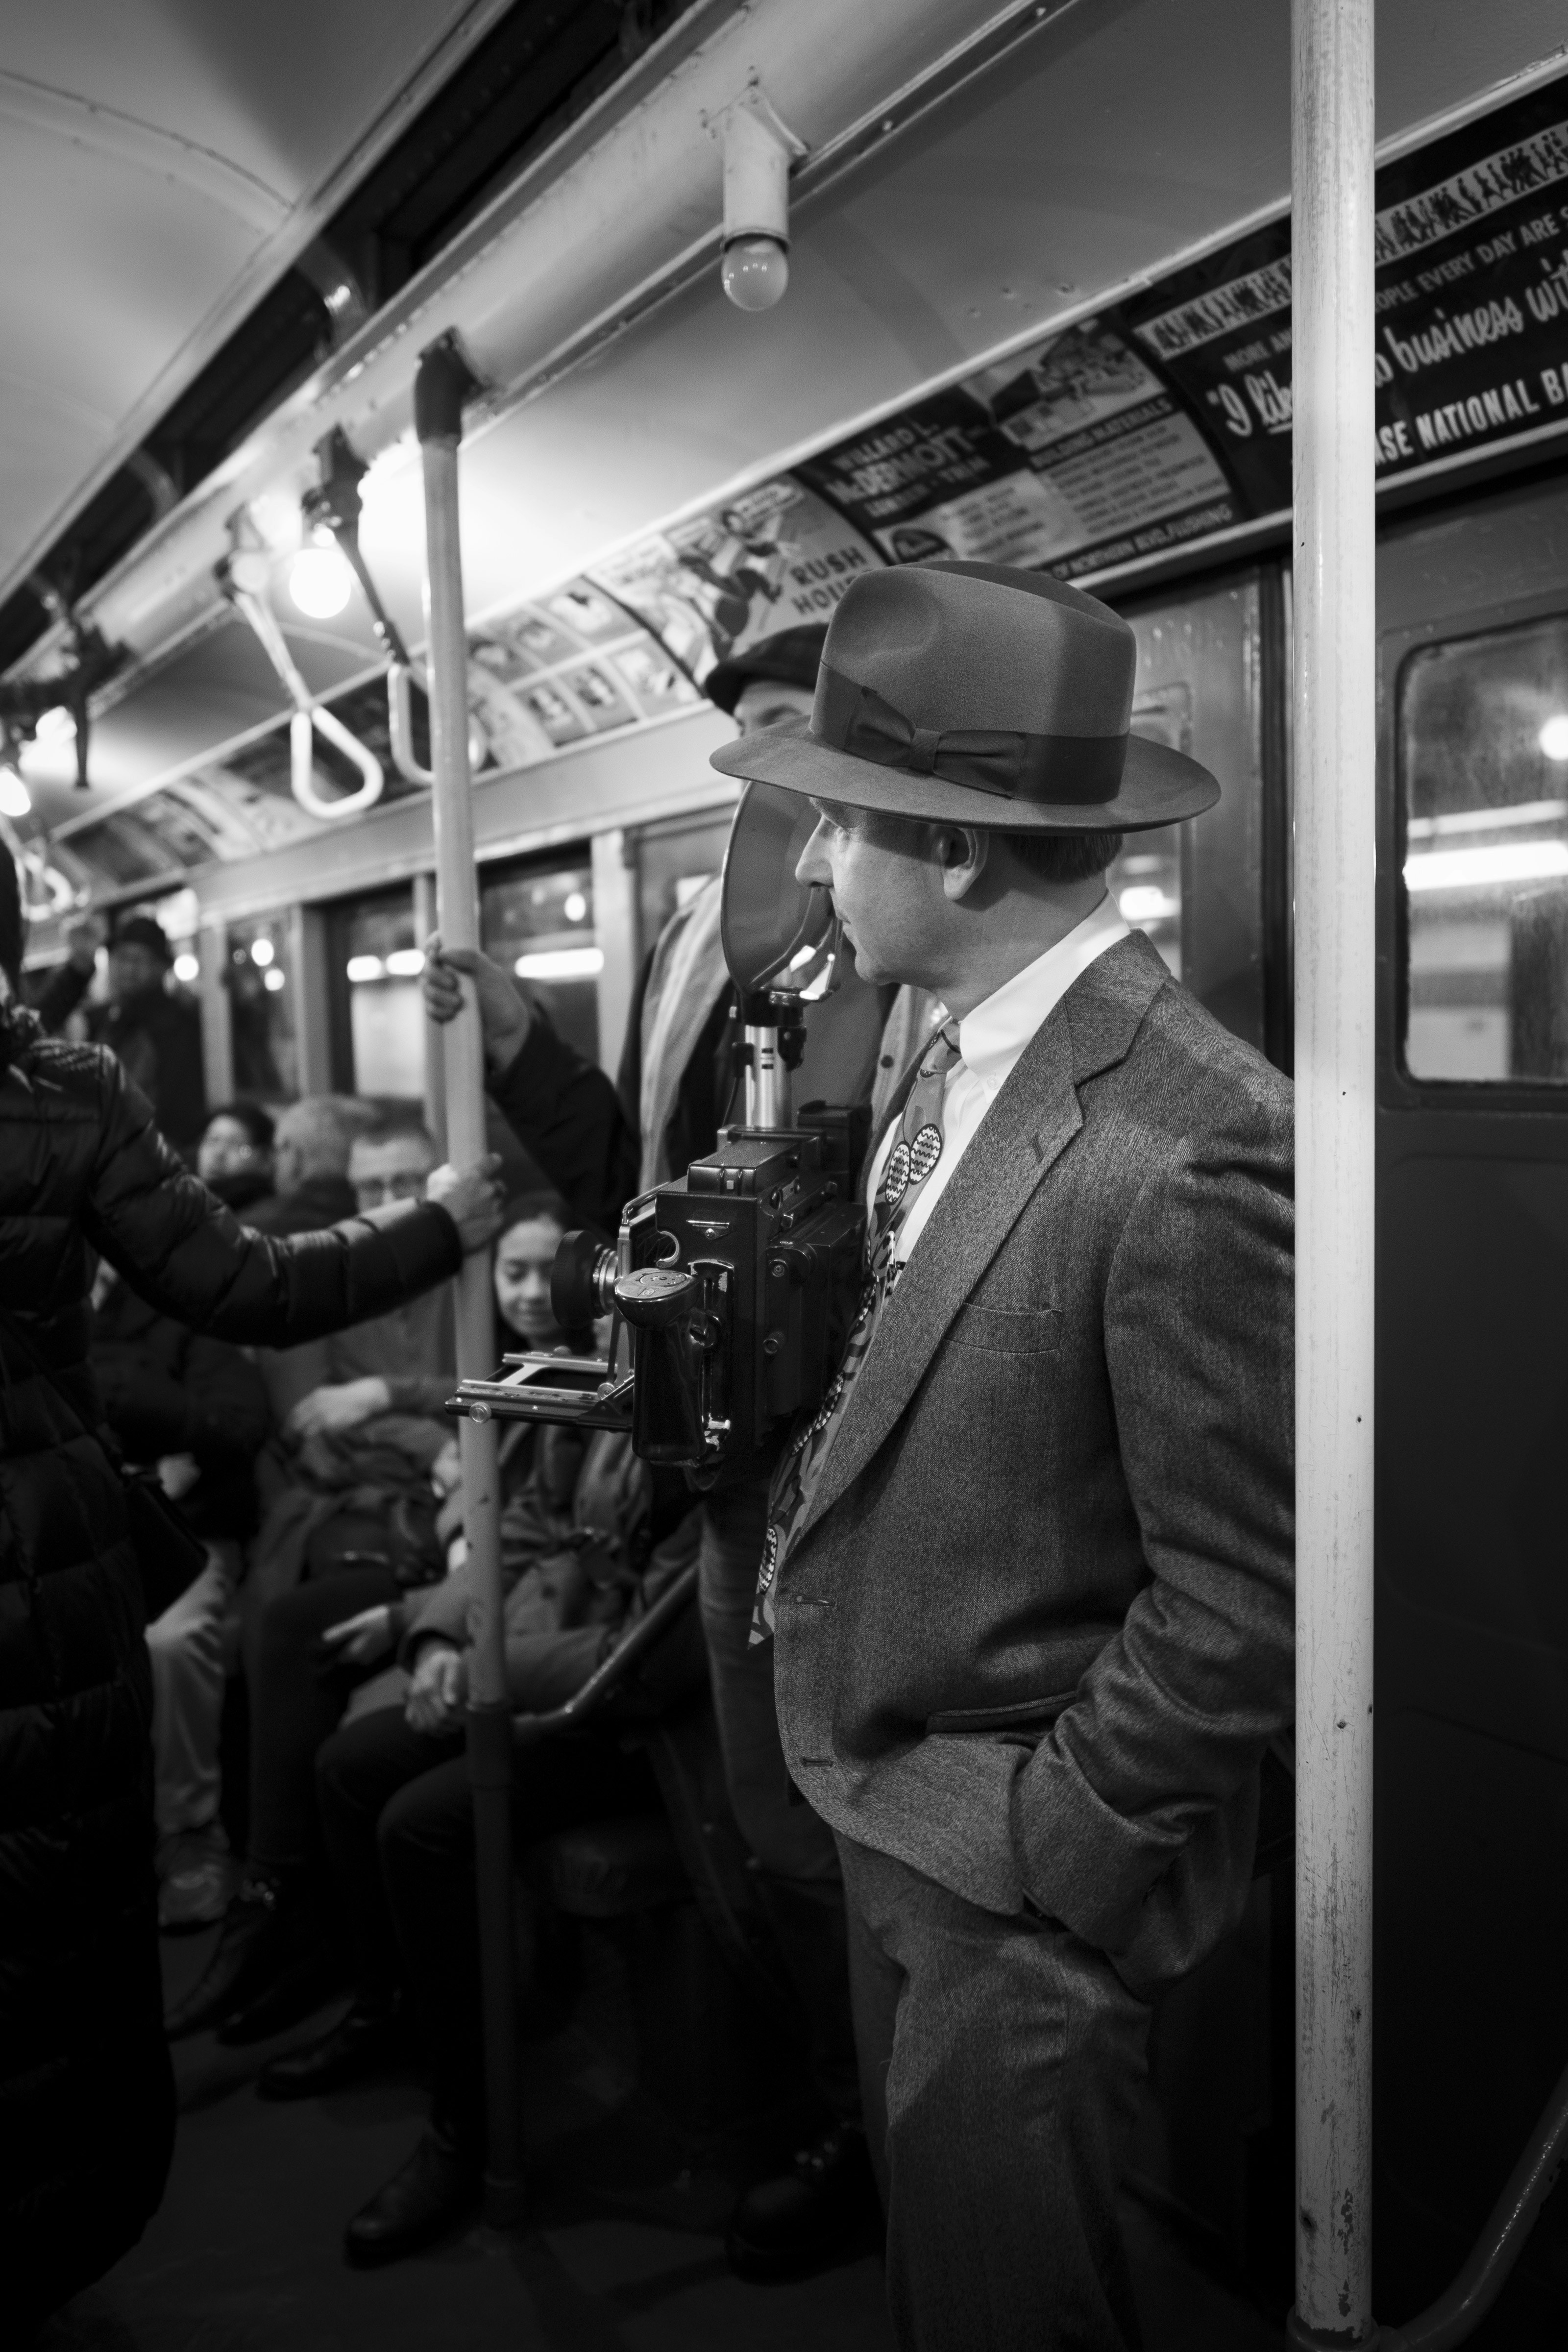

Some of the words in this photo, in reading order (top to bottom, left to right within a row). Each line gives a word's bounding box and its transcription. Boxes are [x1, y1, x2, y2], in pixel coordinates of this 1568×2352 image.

[1374, 281, 1419, 313] OPLE
[1416, 250, 1474, 293] EVERY
[1475, 230, 1517, 264] DAY
[1519, 213, 1561, 246] ARE
[1243, 369, 1292, 427] lik
[1382, 295, 1524, 373] business
[1415, 378, 1542, 450] NATIONAL
[789, 545, 867, 587] RUSH
[790, 574, 857, 616] HOU
